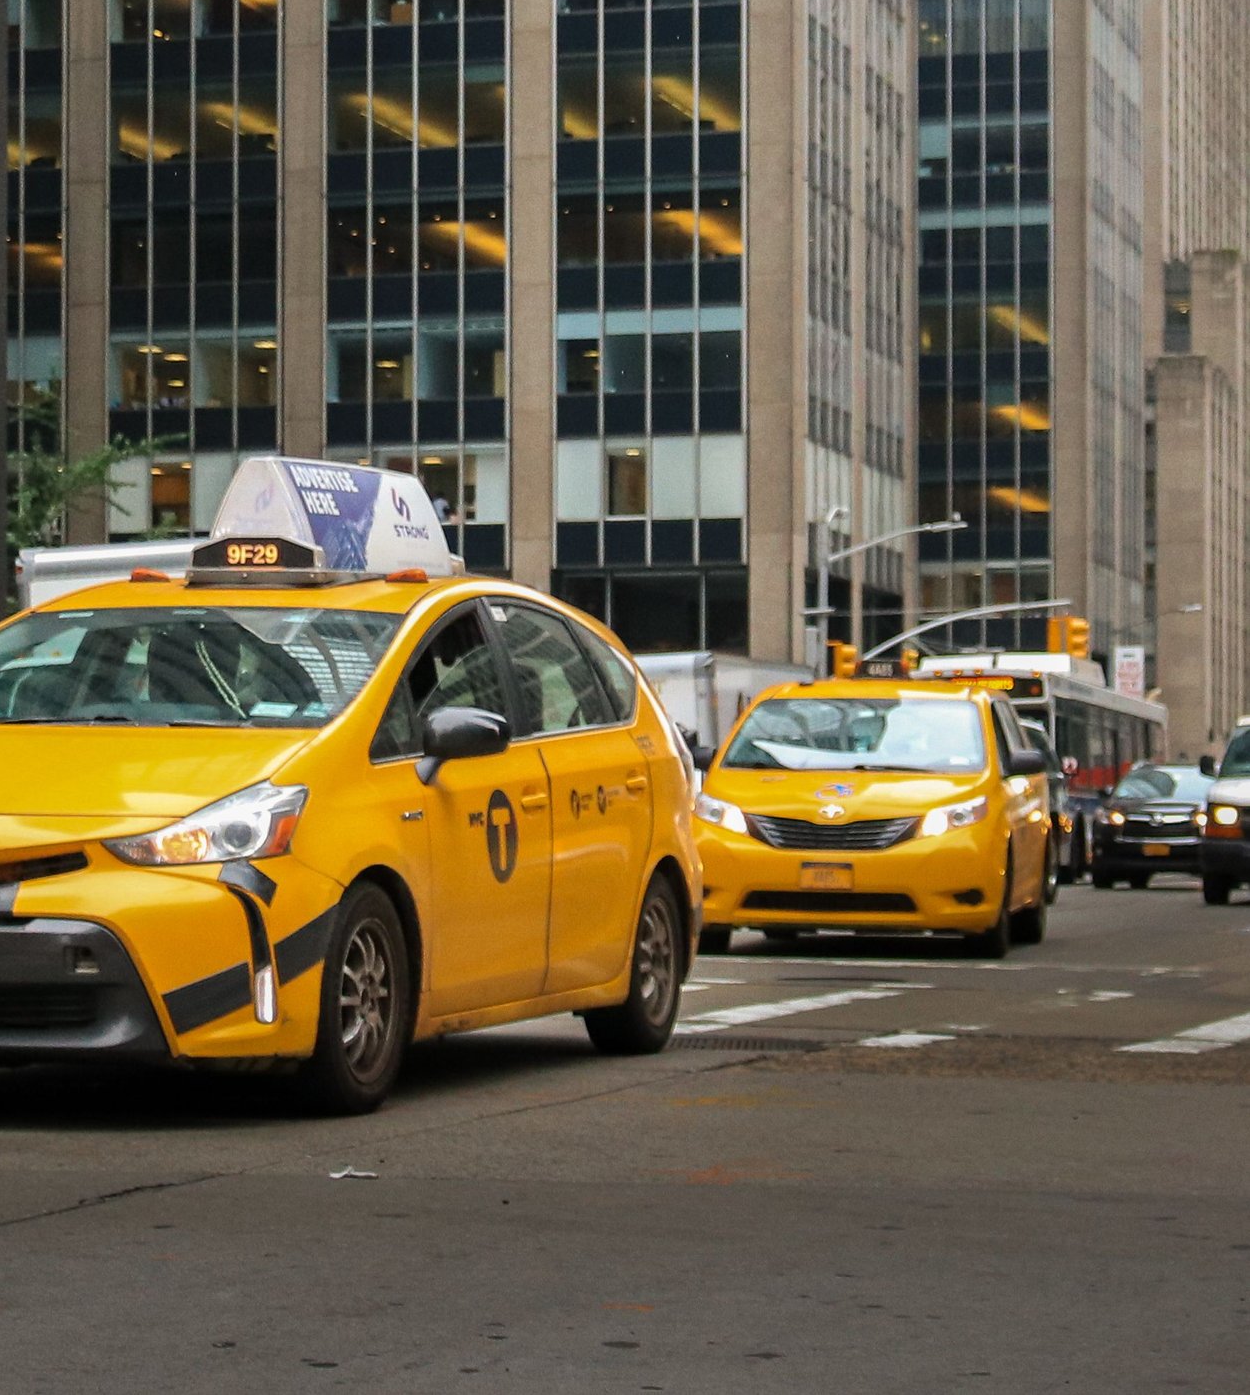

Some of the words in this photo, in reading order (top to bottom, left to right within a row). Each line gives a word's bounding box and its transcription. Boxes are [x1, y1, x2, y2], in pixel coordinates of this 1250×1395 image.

[290, 464, 359, 493] ADVERTISE
[301, 490, 340, 516] HERE
[393, 524, 430, 541] STRONG
[227, 543, 279, 565] 9F29
